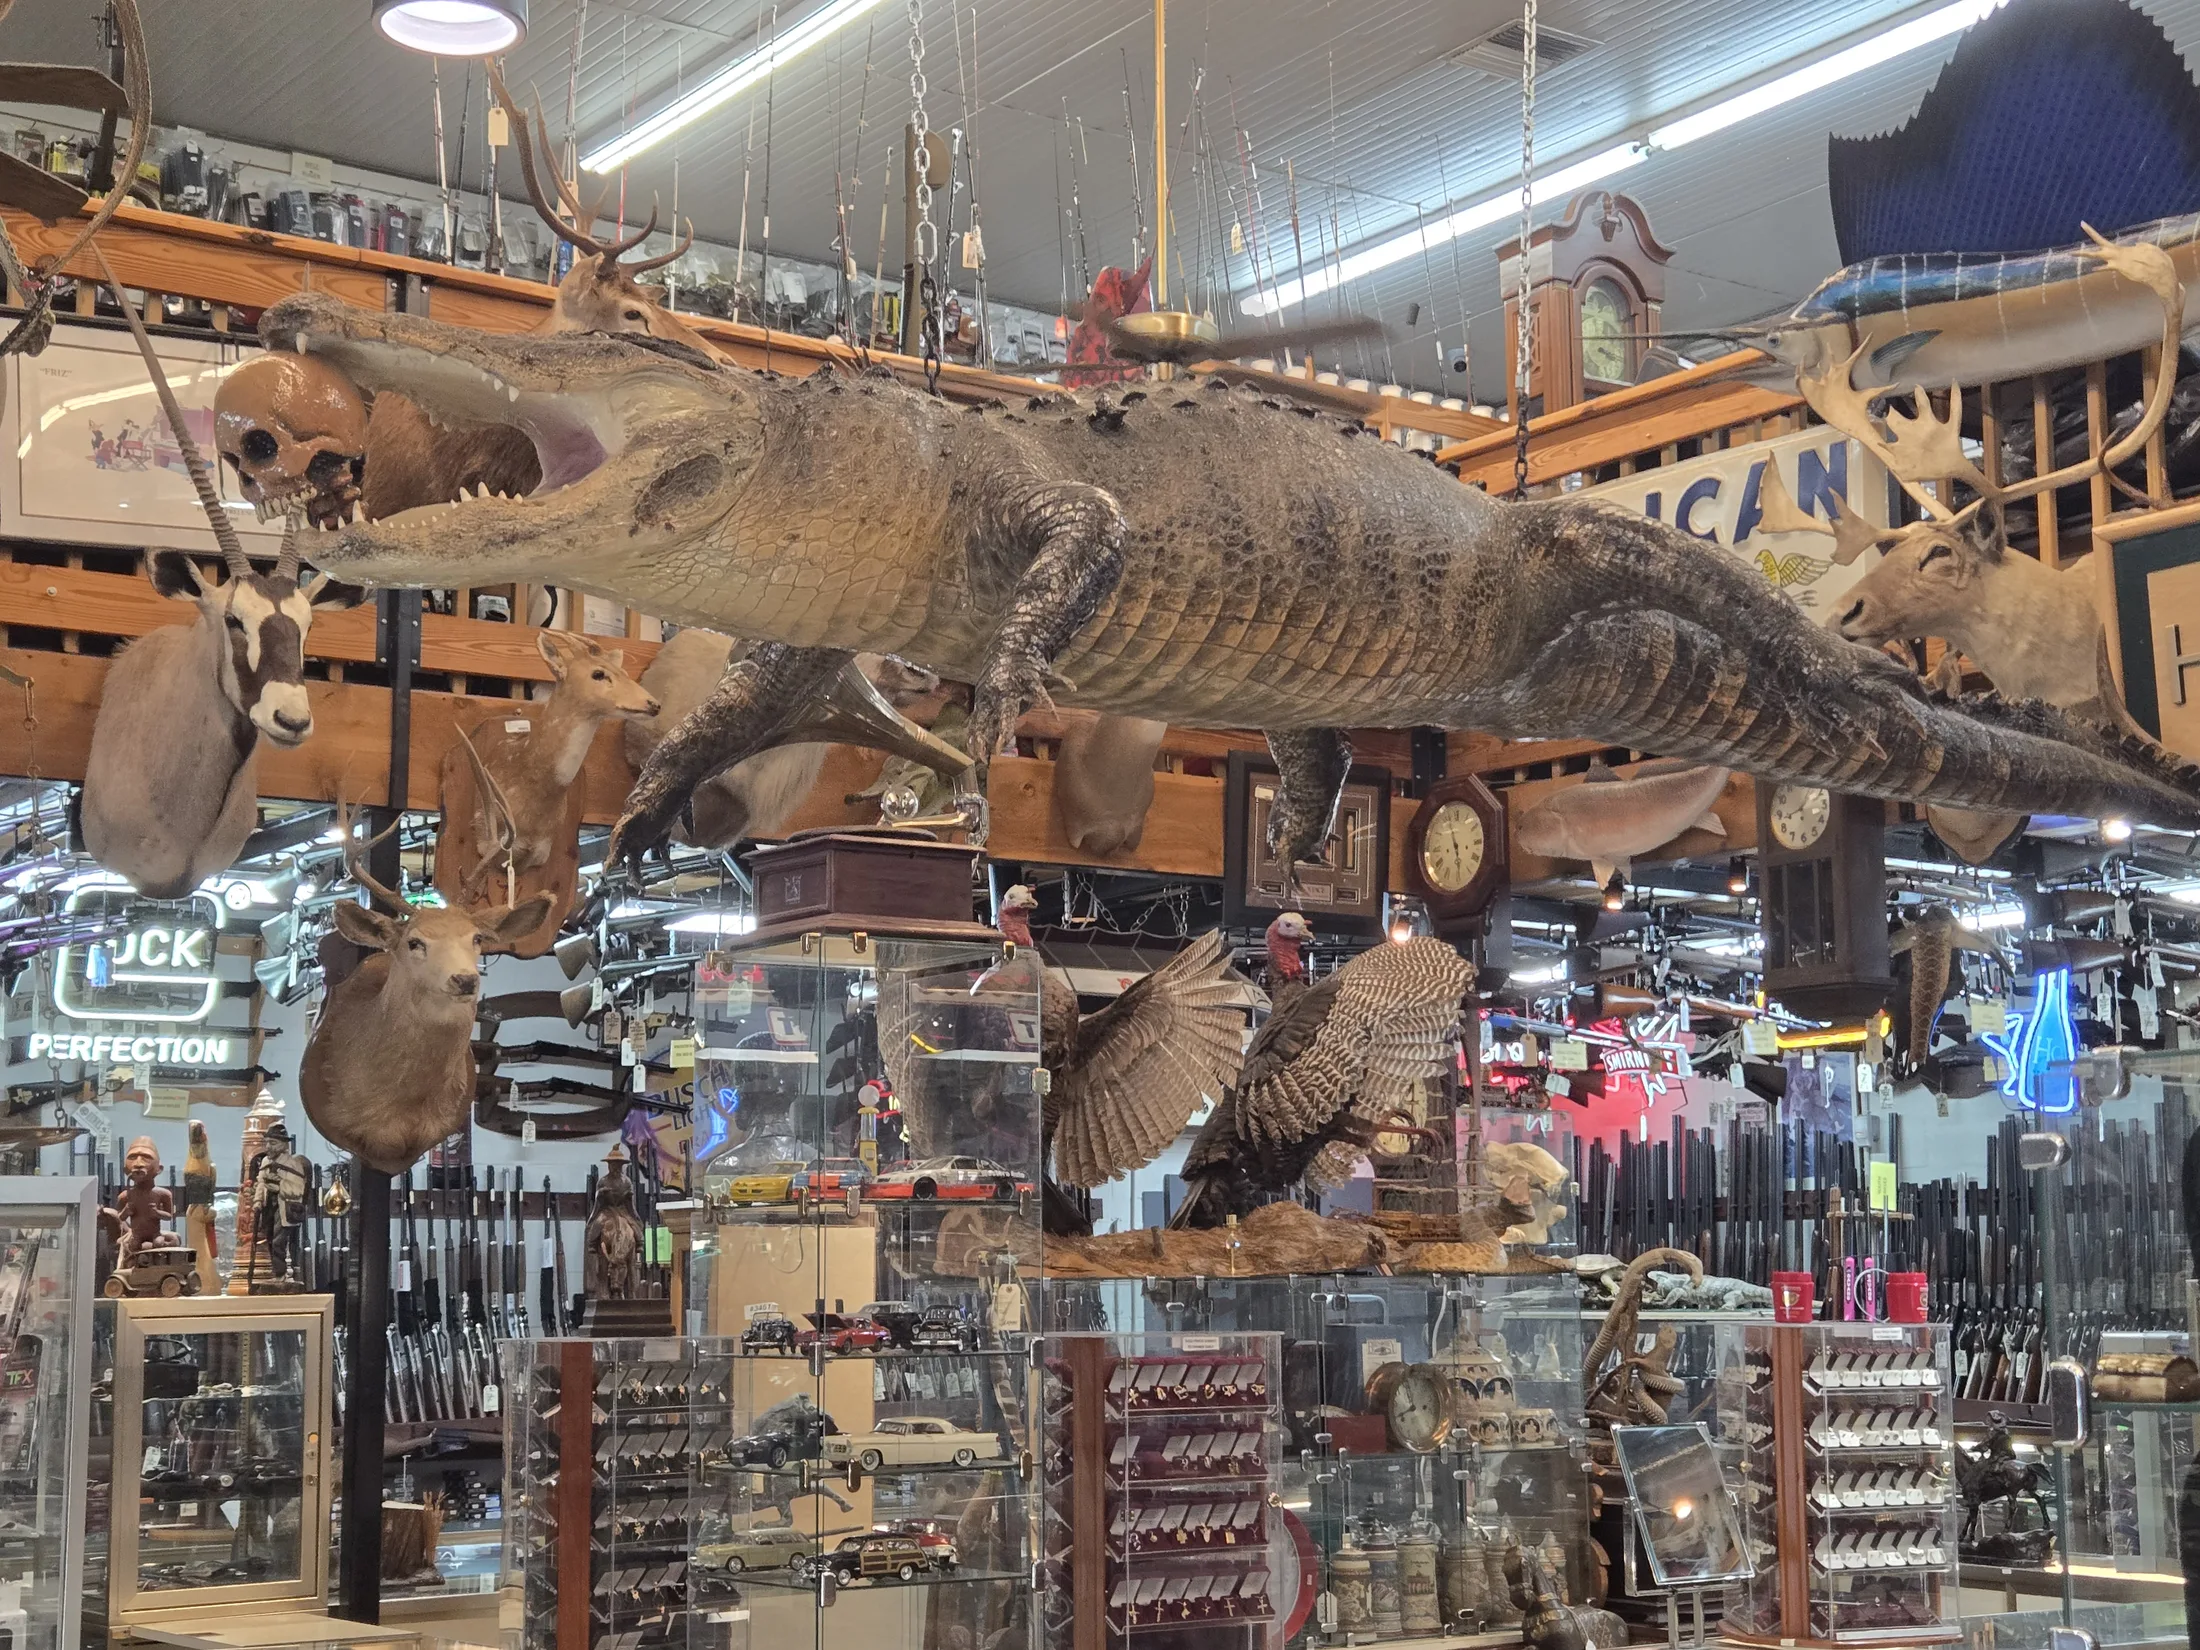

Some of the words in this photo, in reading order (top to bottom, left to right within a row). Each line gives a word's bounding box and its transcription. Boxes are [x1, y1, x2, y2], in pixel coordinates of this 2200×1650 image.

[28, 1032, 229, 1064] PERFECTION
[1605, 1049, 1675, 1073] SMIRNF
[647, 1061, 730, 1120] BUSCH
[6, 1369, 34, 1385] TFX
